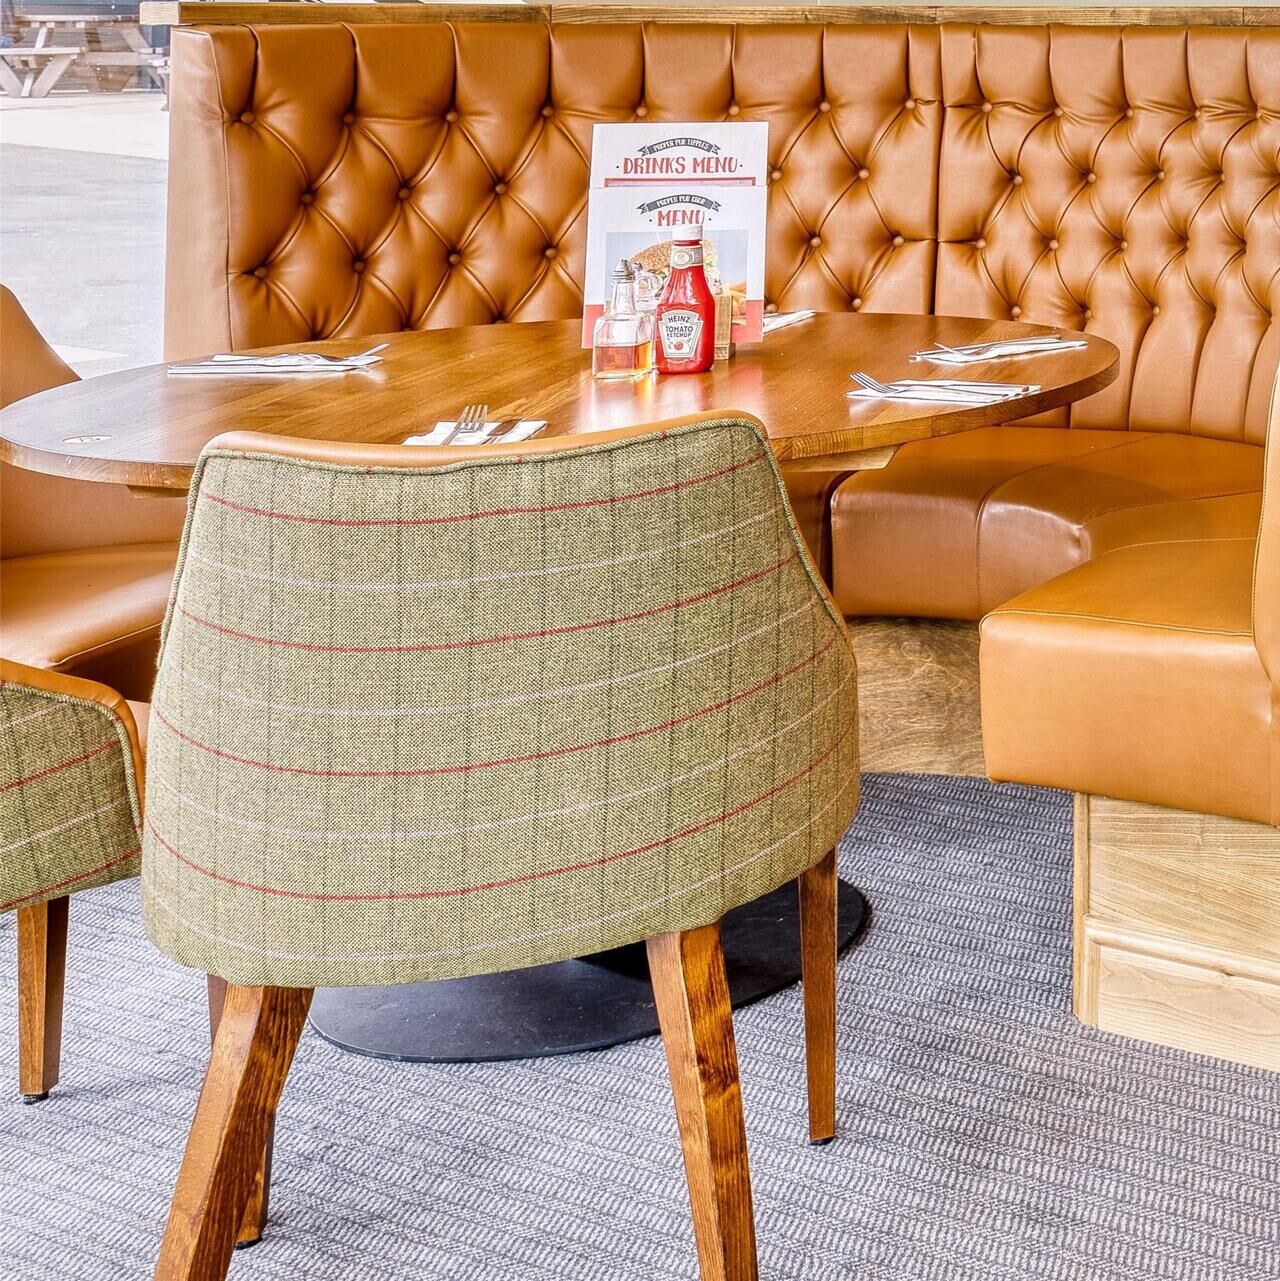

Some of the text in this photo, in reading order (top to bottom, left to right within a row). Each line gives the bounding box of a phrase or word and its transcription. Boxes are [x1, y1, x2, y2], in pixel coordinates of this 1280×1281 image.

[623, 156, 738, 174] DRINKS MENU
[657, 209, 705, 227] MENU
[668, 315, 691, 323] HEINZ
[665, 325, 694, 333] TOMATO
